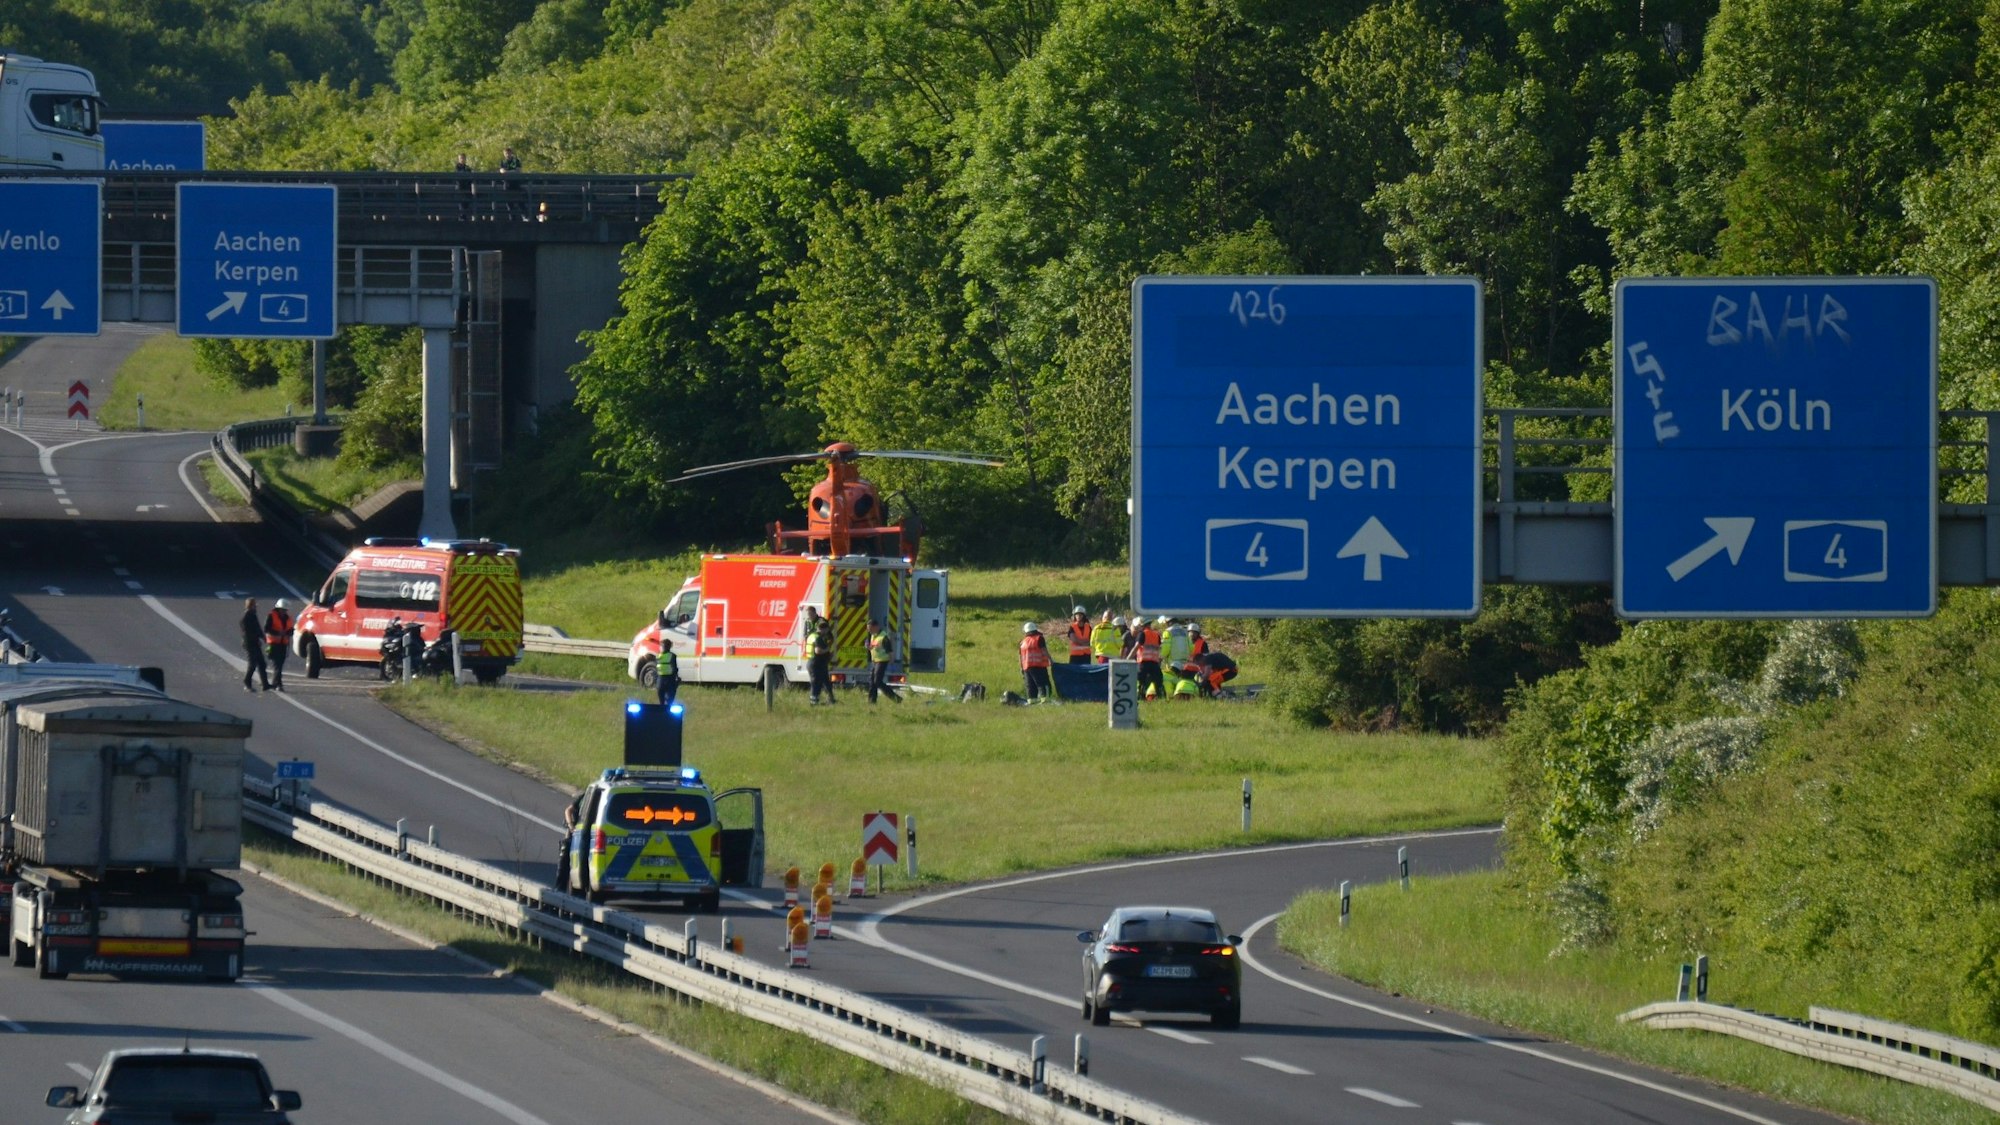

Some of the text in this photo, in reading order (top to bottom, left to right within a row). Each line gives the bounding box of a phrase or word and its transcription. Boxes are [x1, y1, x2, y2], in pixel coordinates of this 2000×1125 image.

[214, 231, 300, 251] Aachen
[215, 260, 298, 286] Kerpen
[278, 300, 289, 316] 4
[1229, 286, 1286, 326] 126
[1706, 290, 1850, 346] BAHR
[1215, 382, 1400, 425] Aachen
[1721, 388, 1831, 431] Köln
[1218, 446, 1396, 500] Kerpen
[1245, 532, 1268, 568] 4
[1824, 534, 1847, 568] 4
[372, 557, 427, 570] EINSATZLEITUNG
[753, 565, 796, 576] FEUERWEHR
[411, 581, 437, 600] 112
[760, 580, 787, 588] KERPEN
[606, 836, 646, 847] POLIZEI
